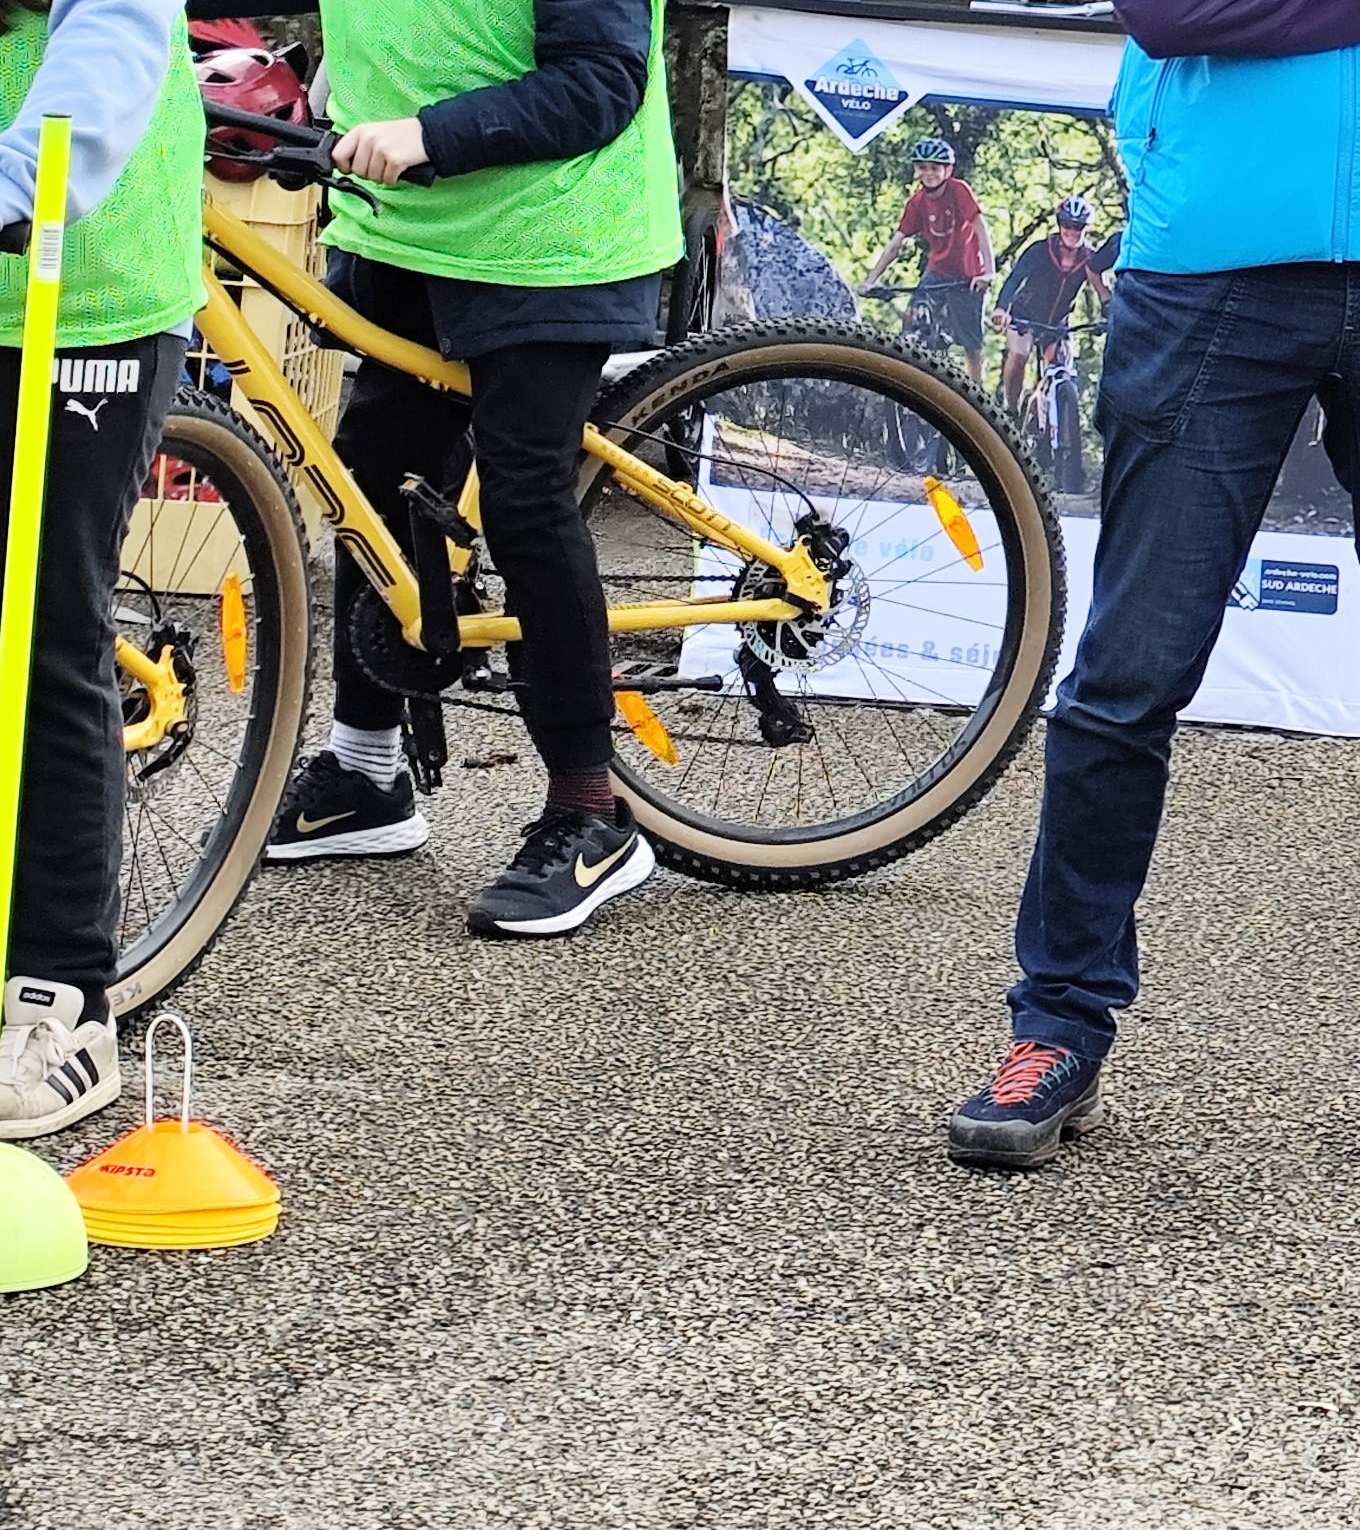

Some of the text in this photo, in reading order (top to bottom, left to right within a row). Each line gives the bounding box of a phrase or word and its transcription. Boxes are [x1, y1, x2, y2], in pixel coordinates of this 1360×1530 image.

[813, 75, 899, 101] Ardèche
[841, 98, 871, 110] VÉLO
[632, 362, 729, 426] KENDA
[653, 477, 741, 531] SCOTT
[1261, 579, 1337, 595] SUD ARDECHE
